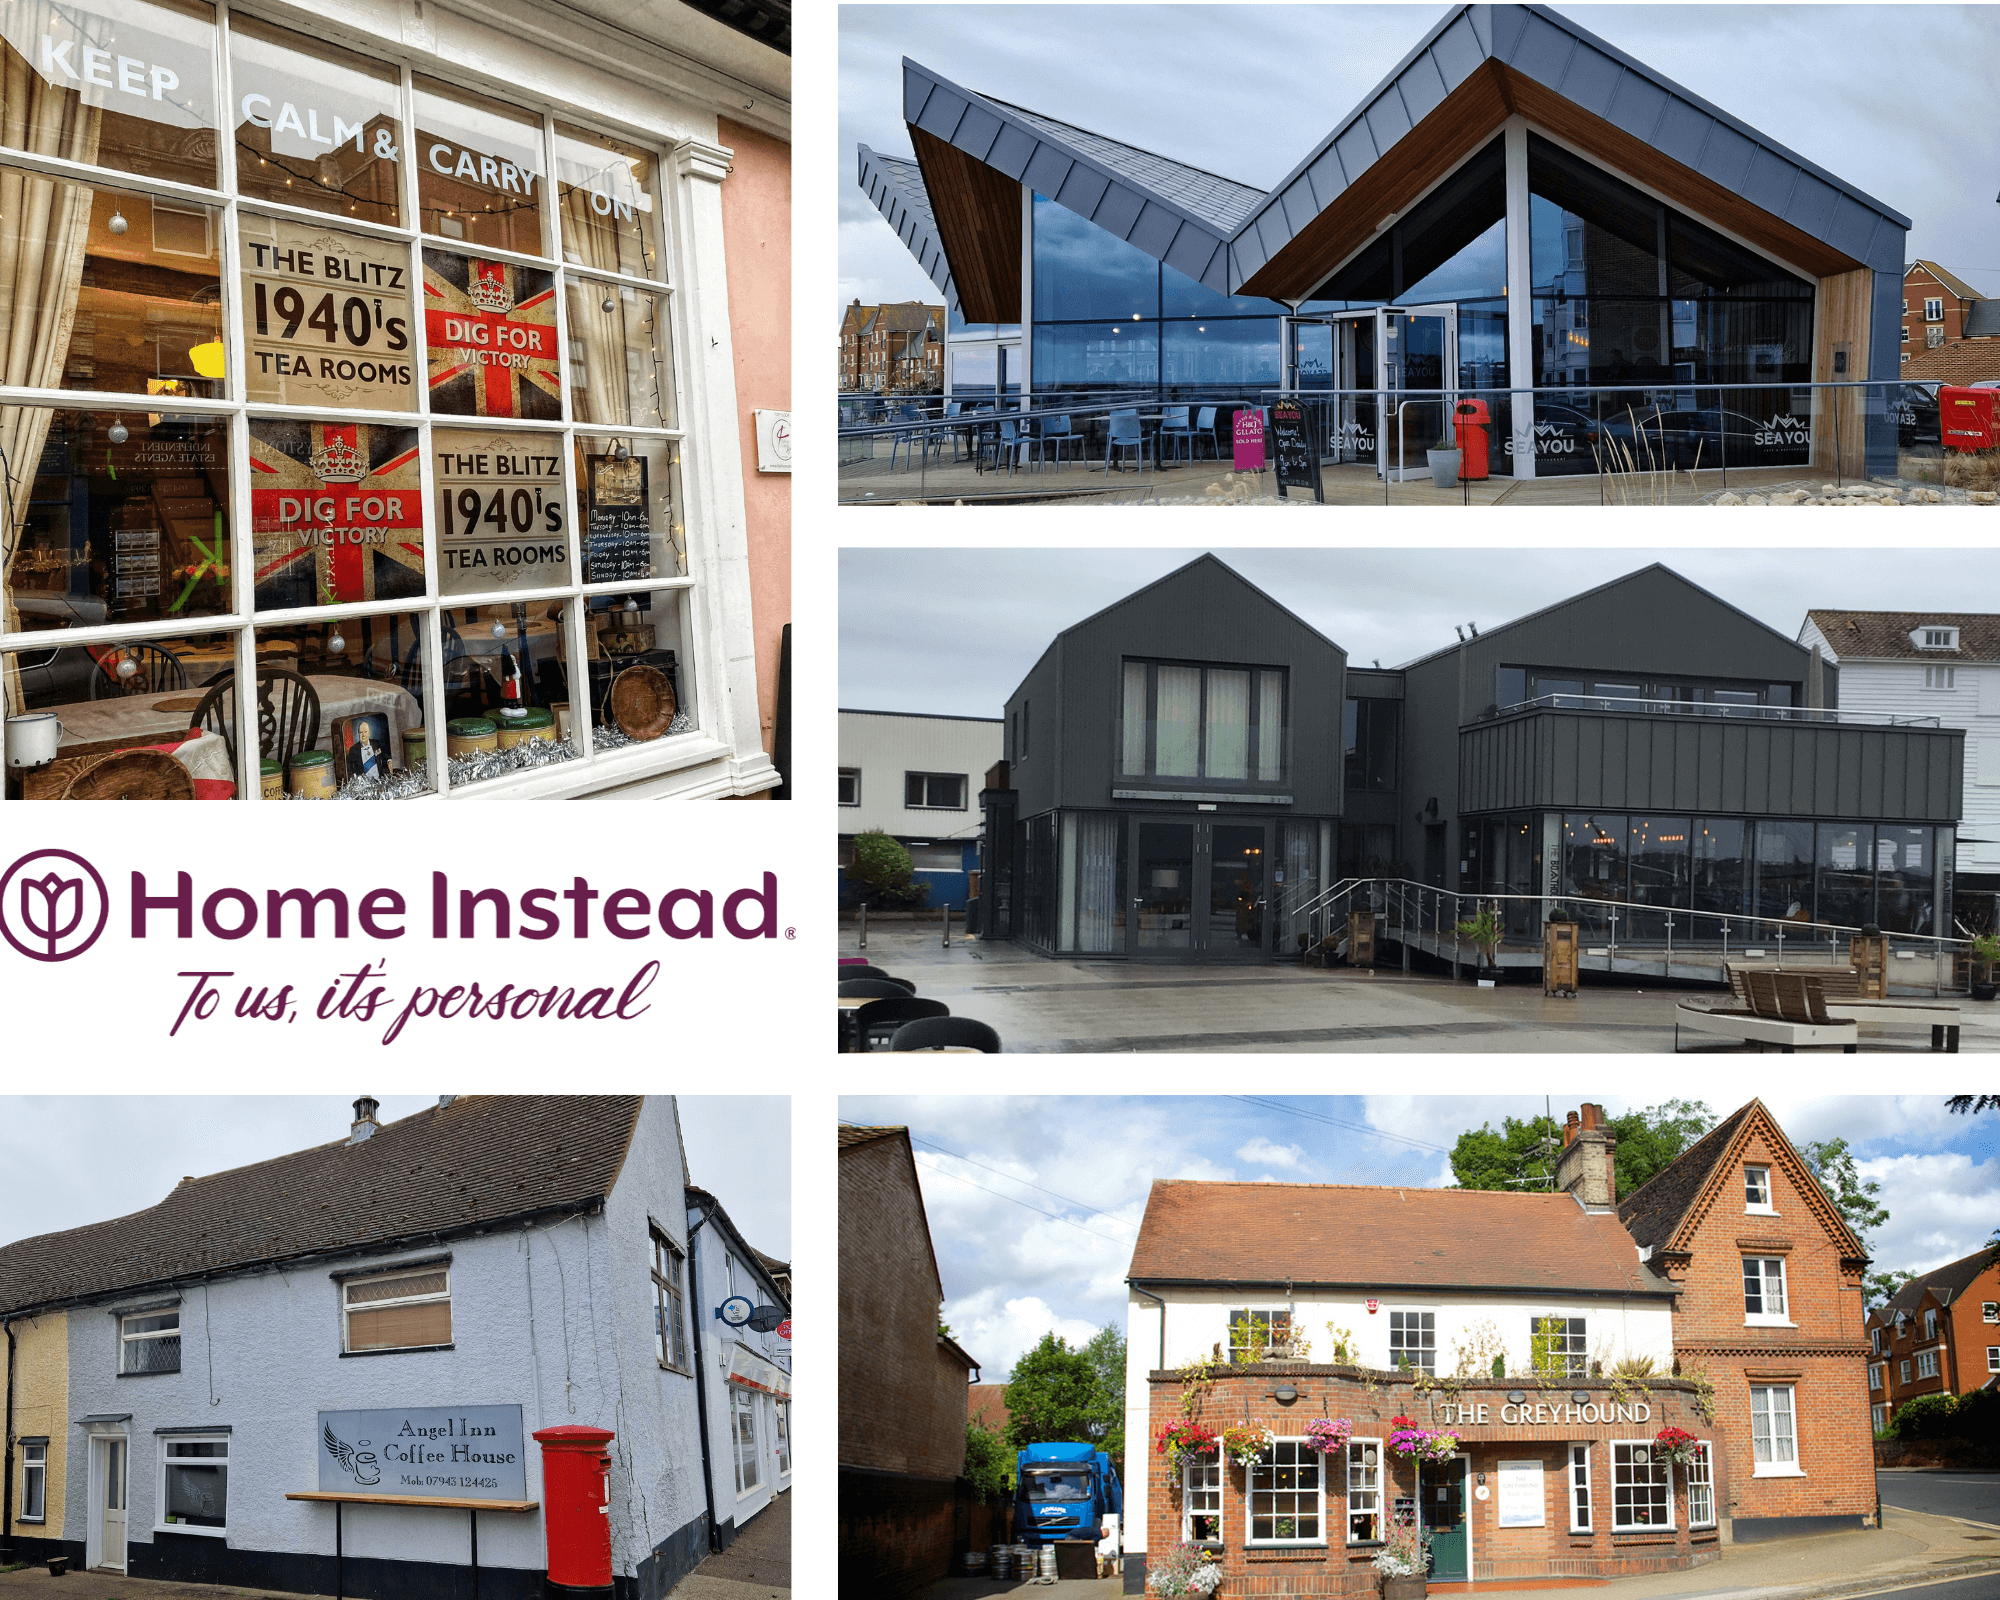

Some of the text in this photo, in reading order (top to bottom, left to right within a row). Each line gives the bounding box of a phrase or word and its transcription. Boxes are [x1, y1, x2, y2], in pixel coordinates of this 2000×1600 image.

[41, 34, 633, 223] KEEP CALM & CARRY ON
[248, 242, 406, 290] THE BLITZ
[254, 282, 408, 352] 1940's
[445, 318, 543, 352] DIG FOR
[254, 351, 411, 386] TEA ROOMS
[459, 347, 532, 370] VICTORY
[438, 453, 561, 476] THE BLITZ
[278, 497, 404, 524] DIG FOR
[442, 487, 563, 536] 1940's
[297, 527, 389, 546] VICTORY
[443, 545, 566, 569] TEA ROOMS
[1440, 1402, 1651, 1425] THE GREYHOUND
[397, 1417, 497, 1440] Angel Inn
[383, 1443, 516, 1464] Coffee House
[400, 1475, 498, 1489] Mob: 07943 124425
